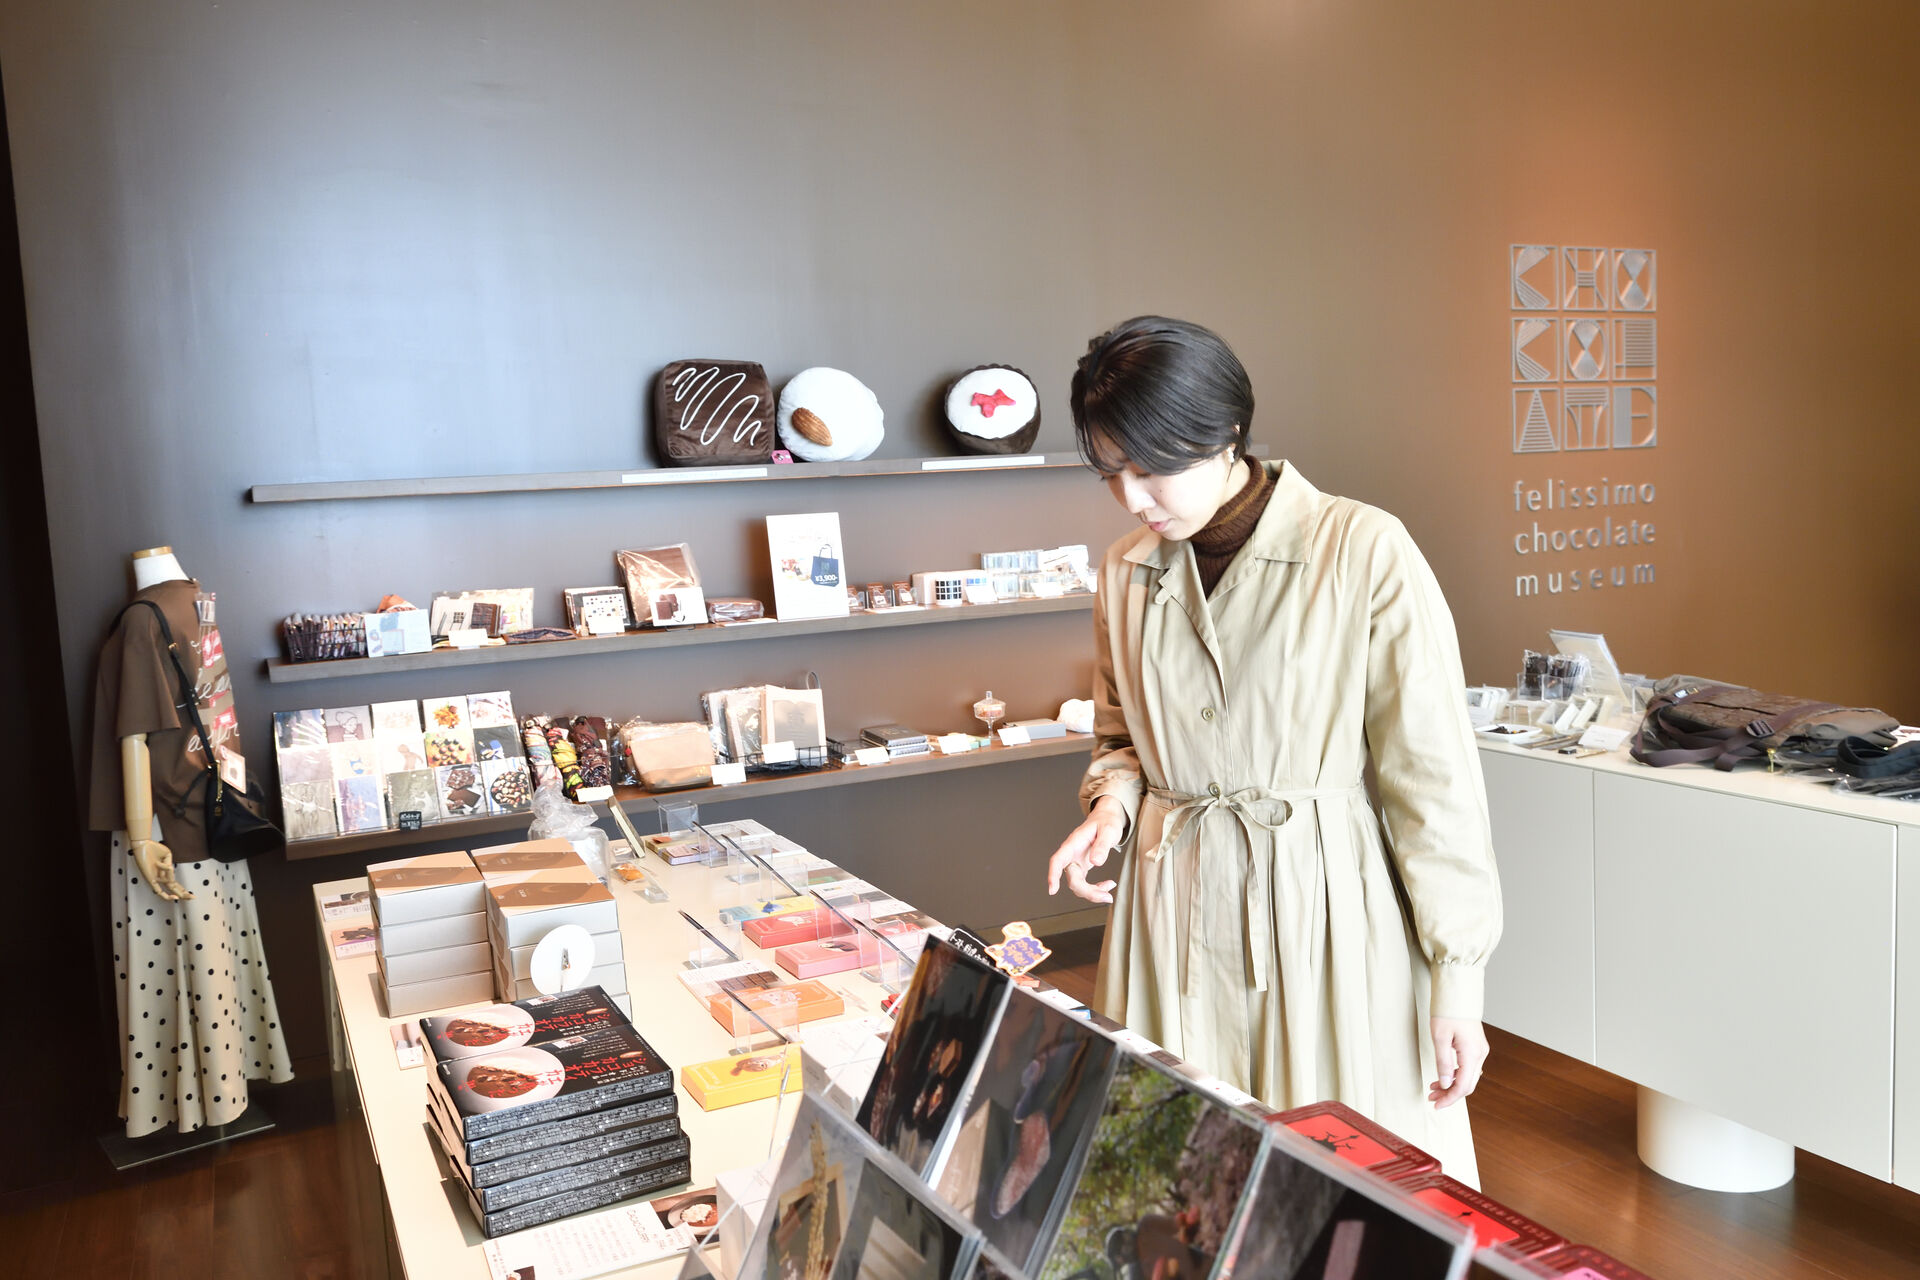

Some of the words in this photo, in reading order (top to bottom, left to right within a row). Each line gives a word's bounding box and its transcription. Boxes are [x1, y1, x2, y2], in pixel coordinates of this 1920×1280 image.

[1513, 477, 1656, 512] felissimo
[1514, 516, 1656, 554] chocolate
[1515, 562, 1656, 597] museum
